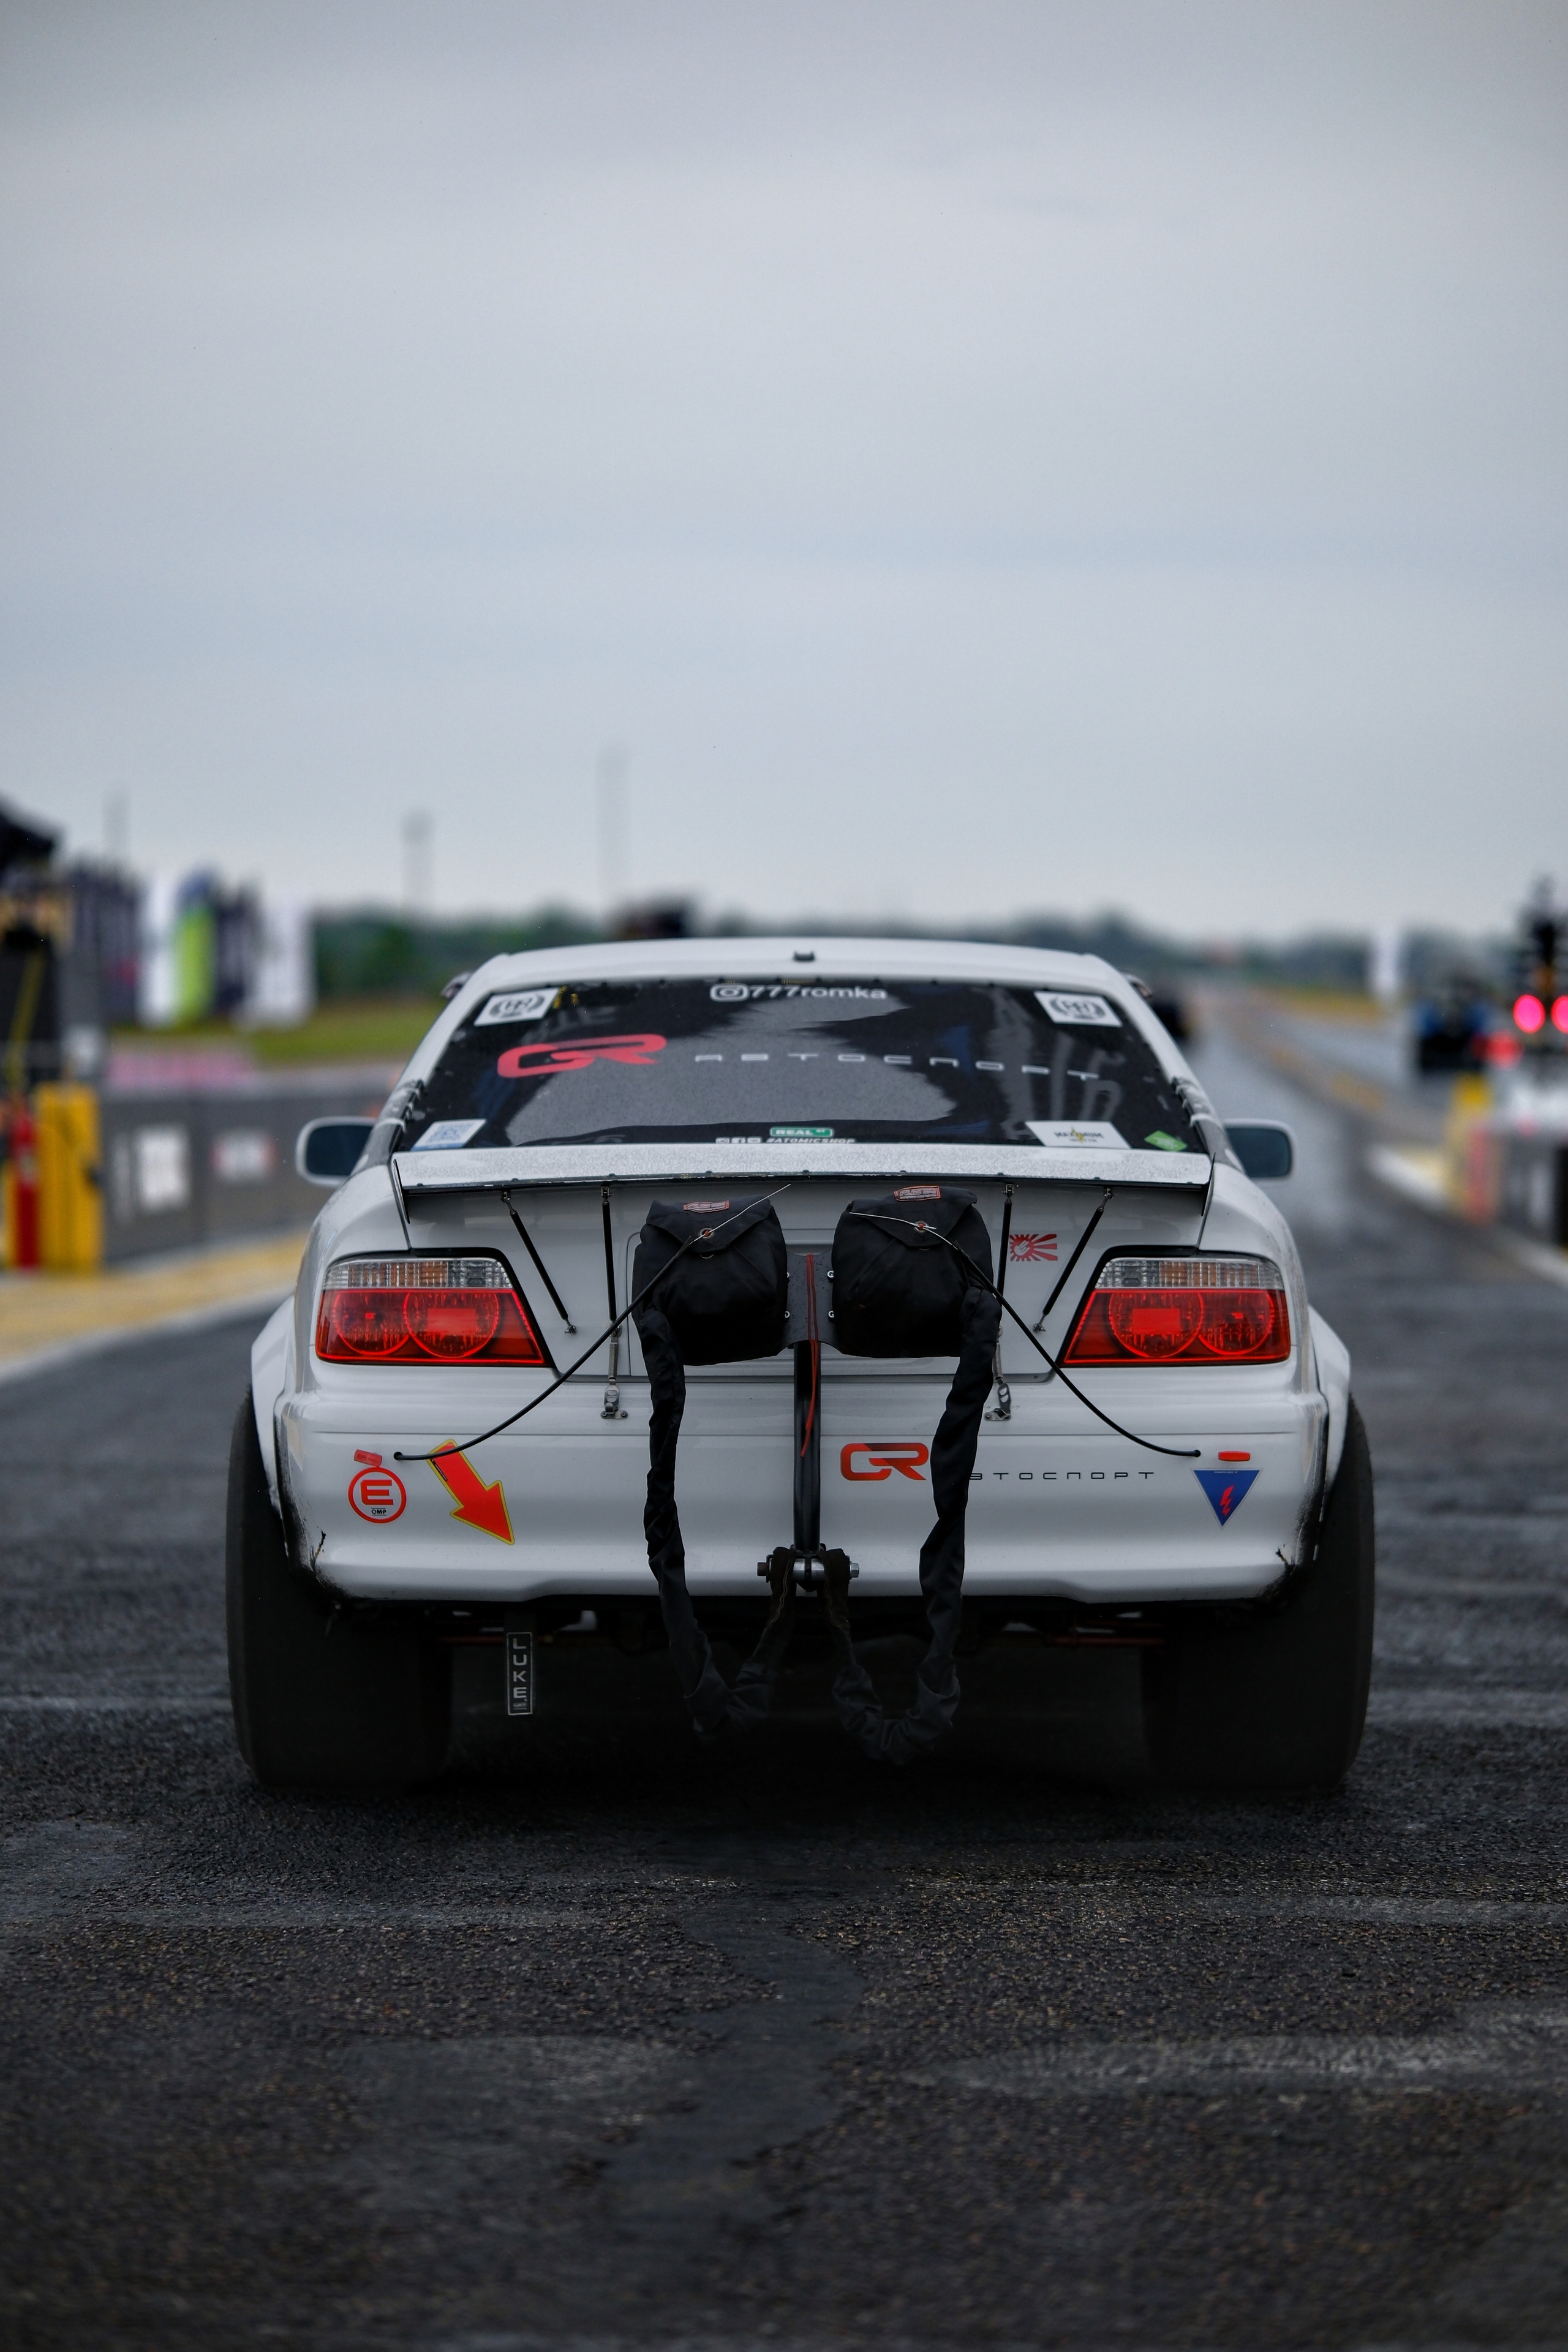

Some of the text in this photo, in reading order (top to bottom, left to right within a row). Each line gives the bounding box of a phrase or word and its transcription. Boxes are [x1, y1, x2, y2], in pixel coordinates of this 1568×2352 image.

[750, 985, 887, 999] 777romka
[497, 1033, 666, 1078] GR
[840, 1442, 929, 1481] GR
[360, 1479, 394, 1505] E
[513, 1638, 527, 1698] LUKE
